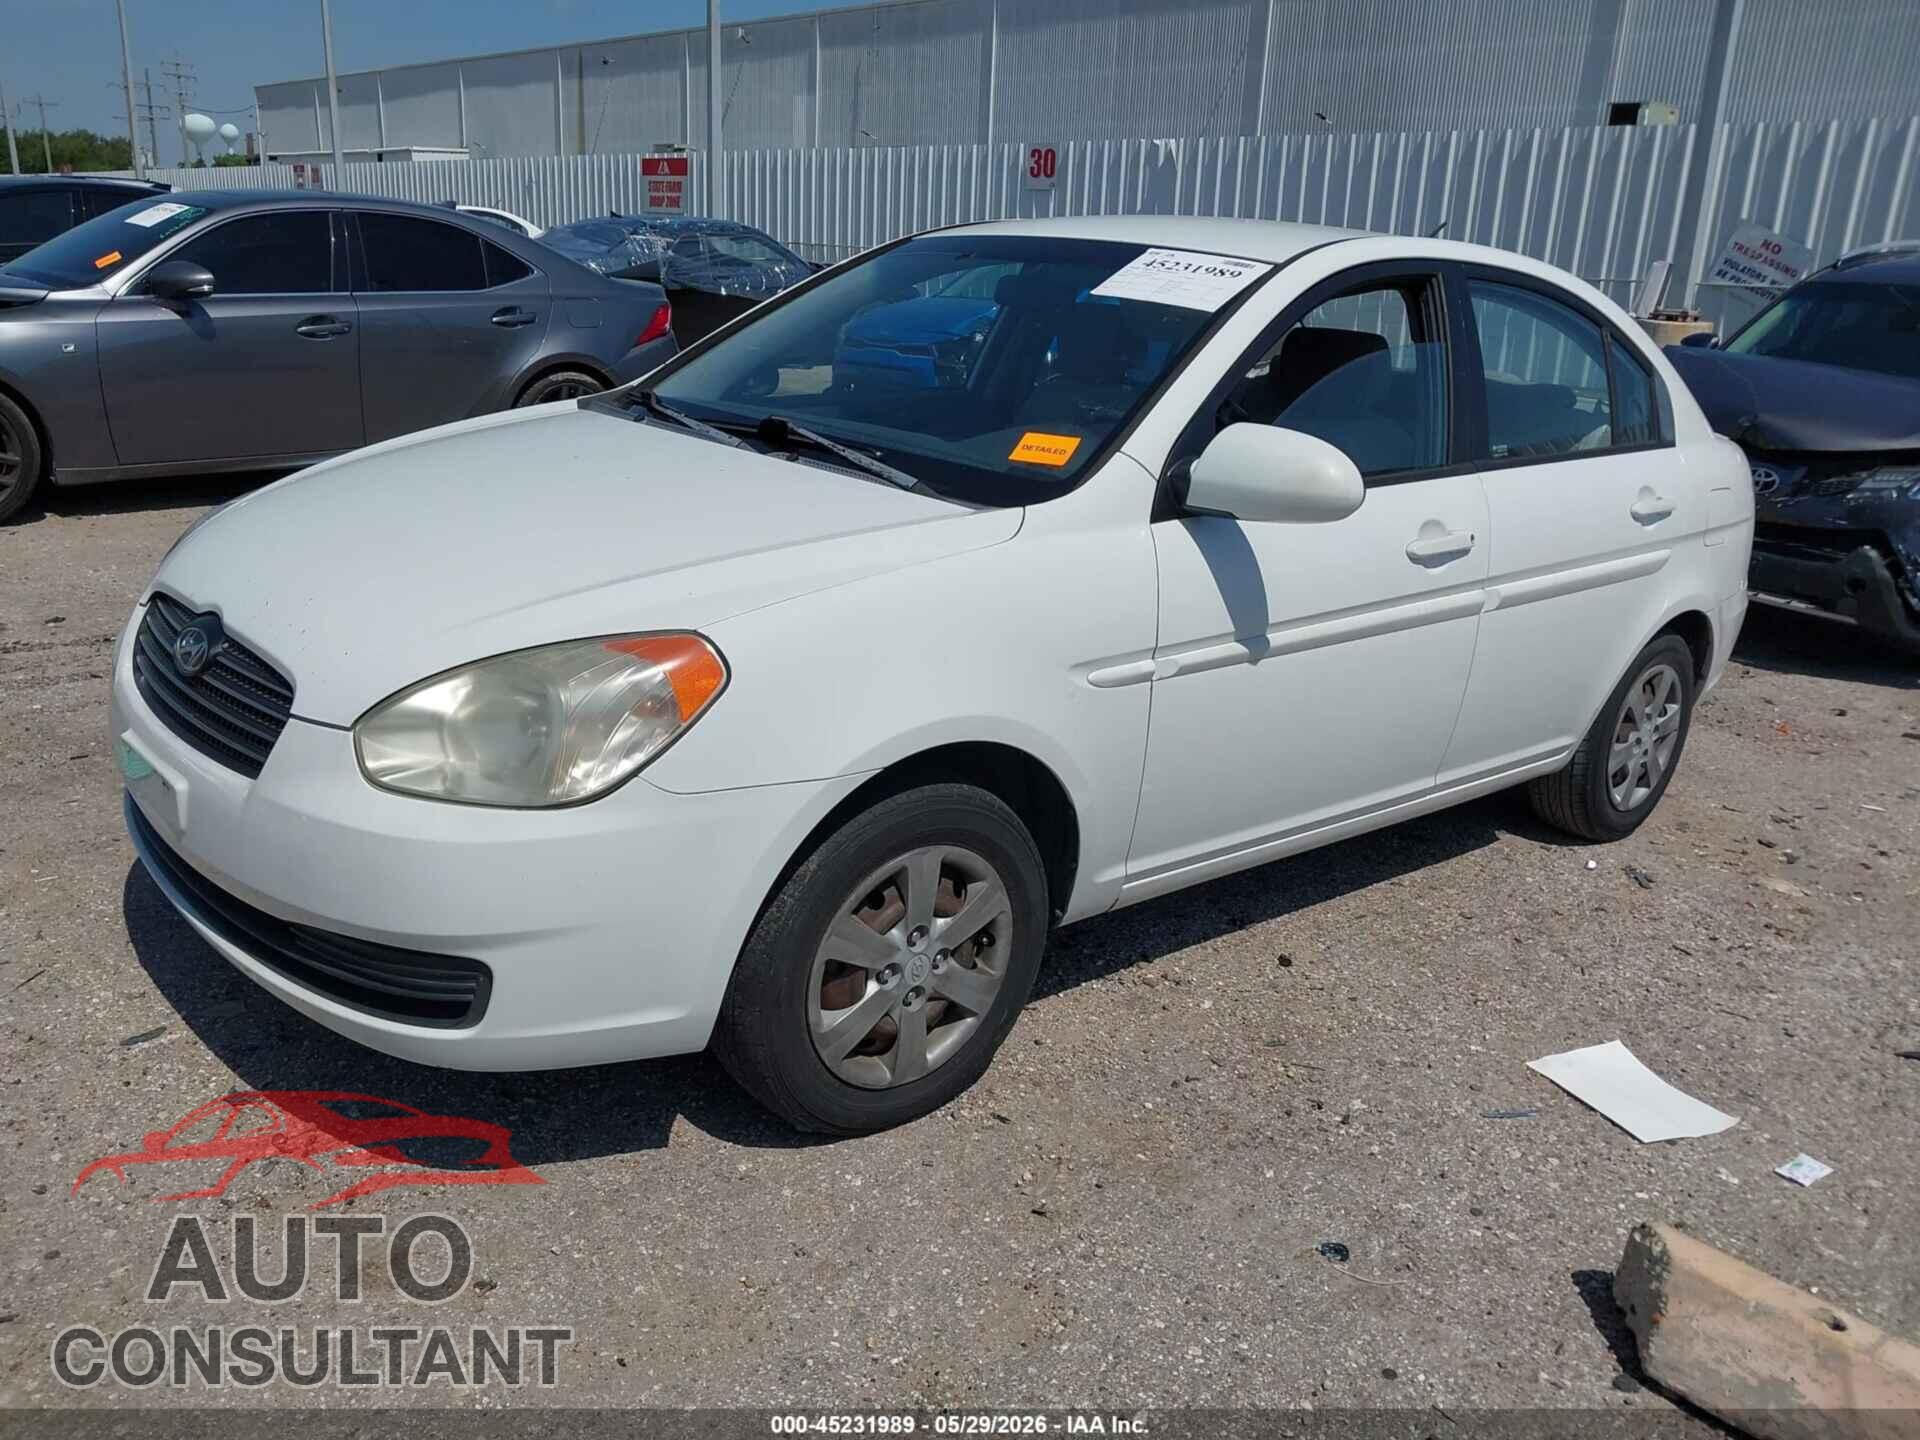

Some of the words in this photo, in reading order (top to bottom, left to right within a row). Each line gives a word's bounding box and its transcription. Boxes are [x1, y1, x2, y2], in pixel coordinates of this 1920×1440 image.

[1030, 148, 1056, 178] 30
[1760, 239, 1782, 255] NO
[1142, 257, 1243, 279] 45231989
[1732, 241, 1798, 278] TRESPASSING
[1022, 443, 1067, 456] DETAILED
